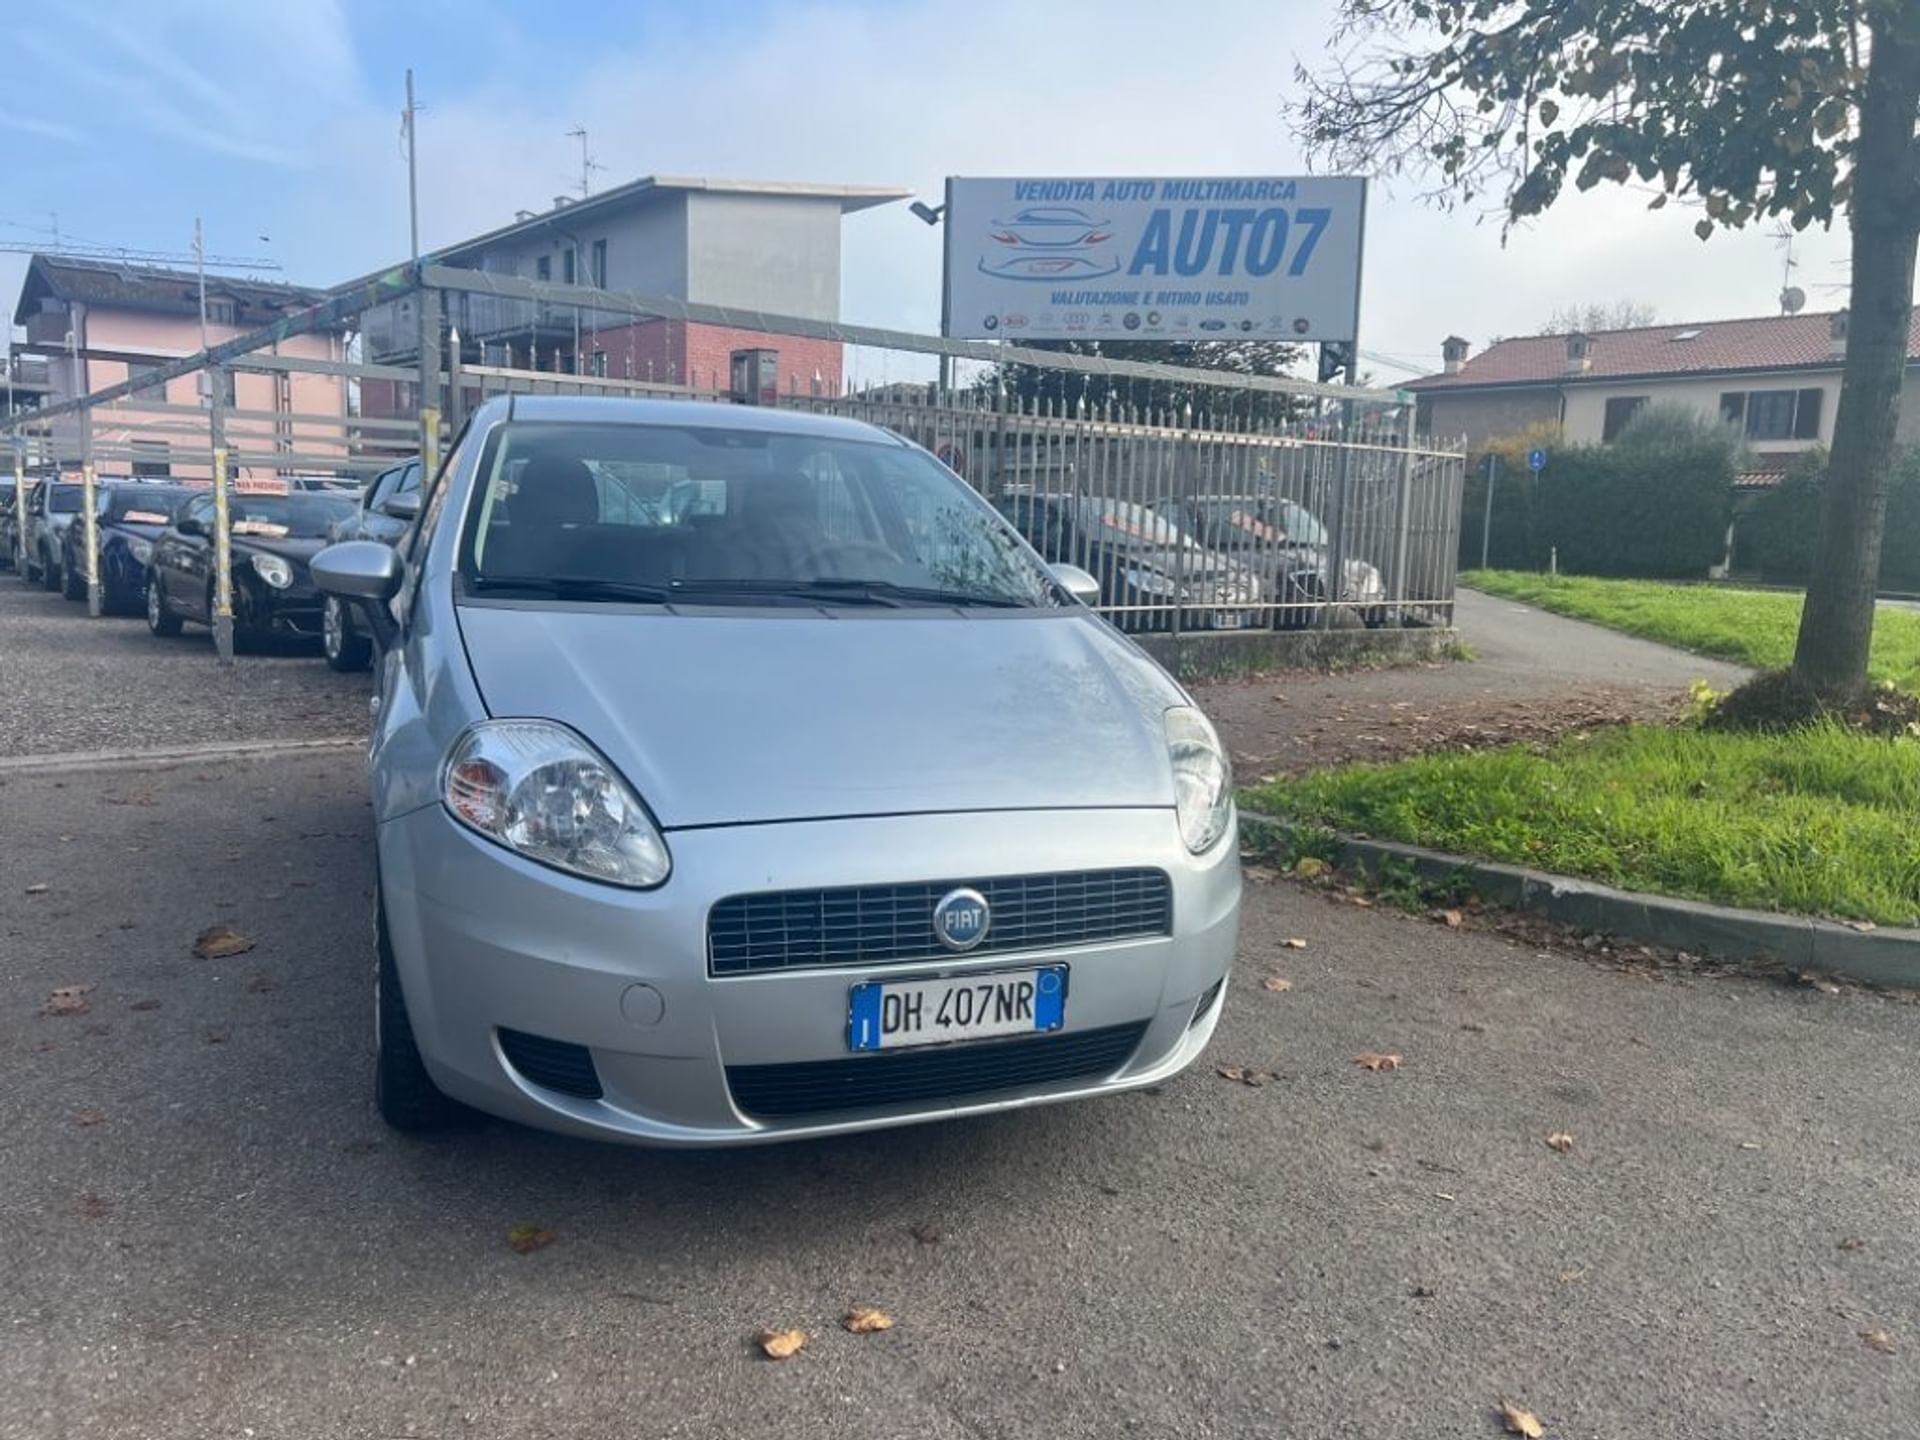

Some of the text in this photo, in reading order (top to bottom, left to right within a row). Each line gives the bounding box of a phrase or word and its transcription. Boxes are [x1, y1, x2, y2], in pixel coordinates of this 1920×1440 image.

[1014, 181, 1297, 200] VENDITA AUTO MULTIMARCA
[1126, 207, 1332, 278] AUTO7
[1050, 290, 1250, 306] VALUTAZIONE E RITIRO USATO
[944, 908, 982, 931] FIAT
[882, 991, 923, 1034] DH
[935, 980, 1034, 1027] 407NR
